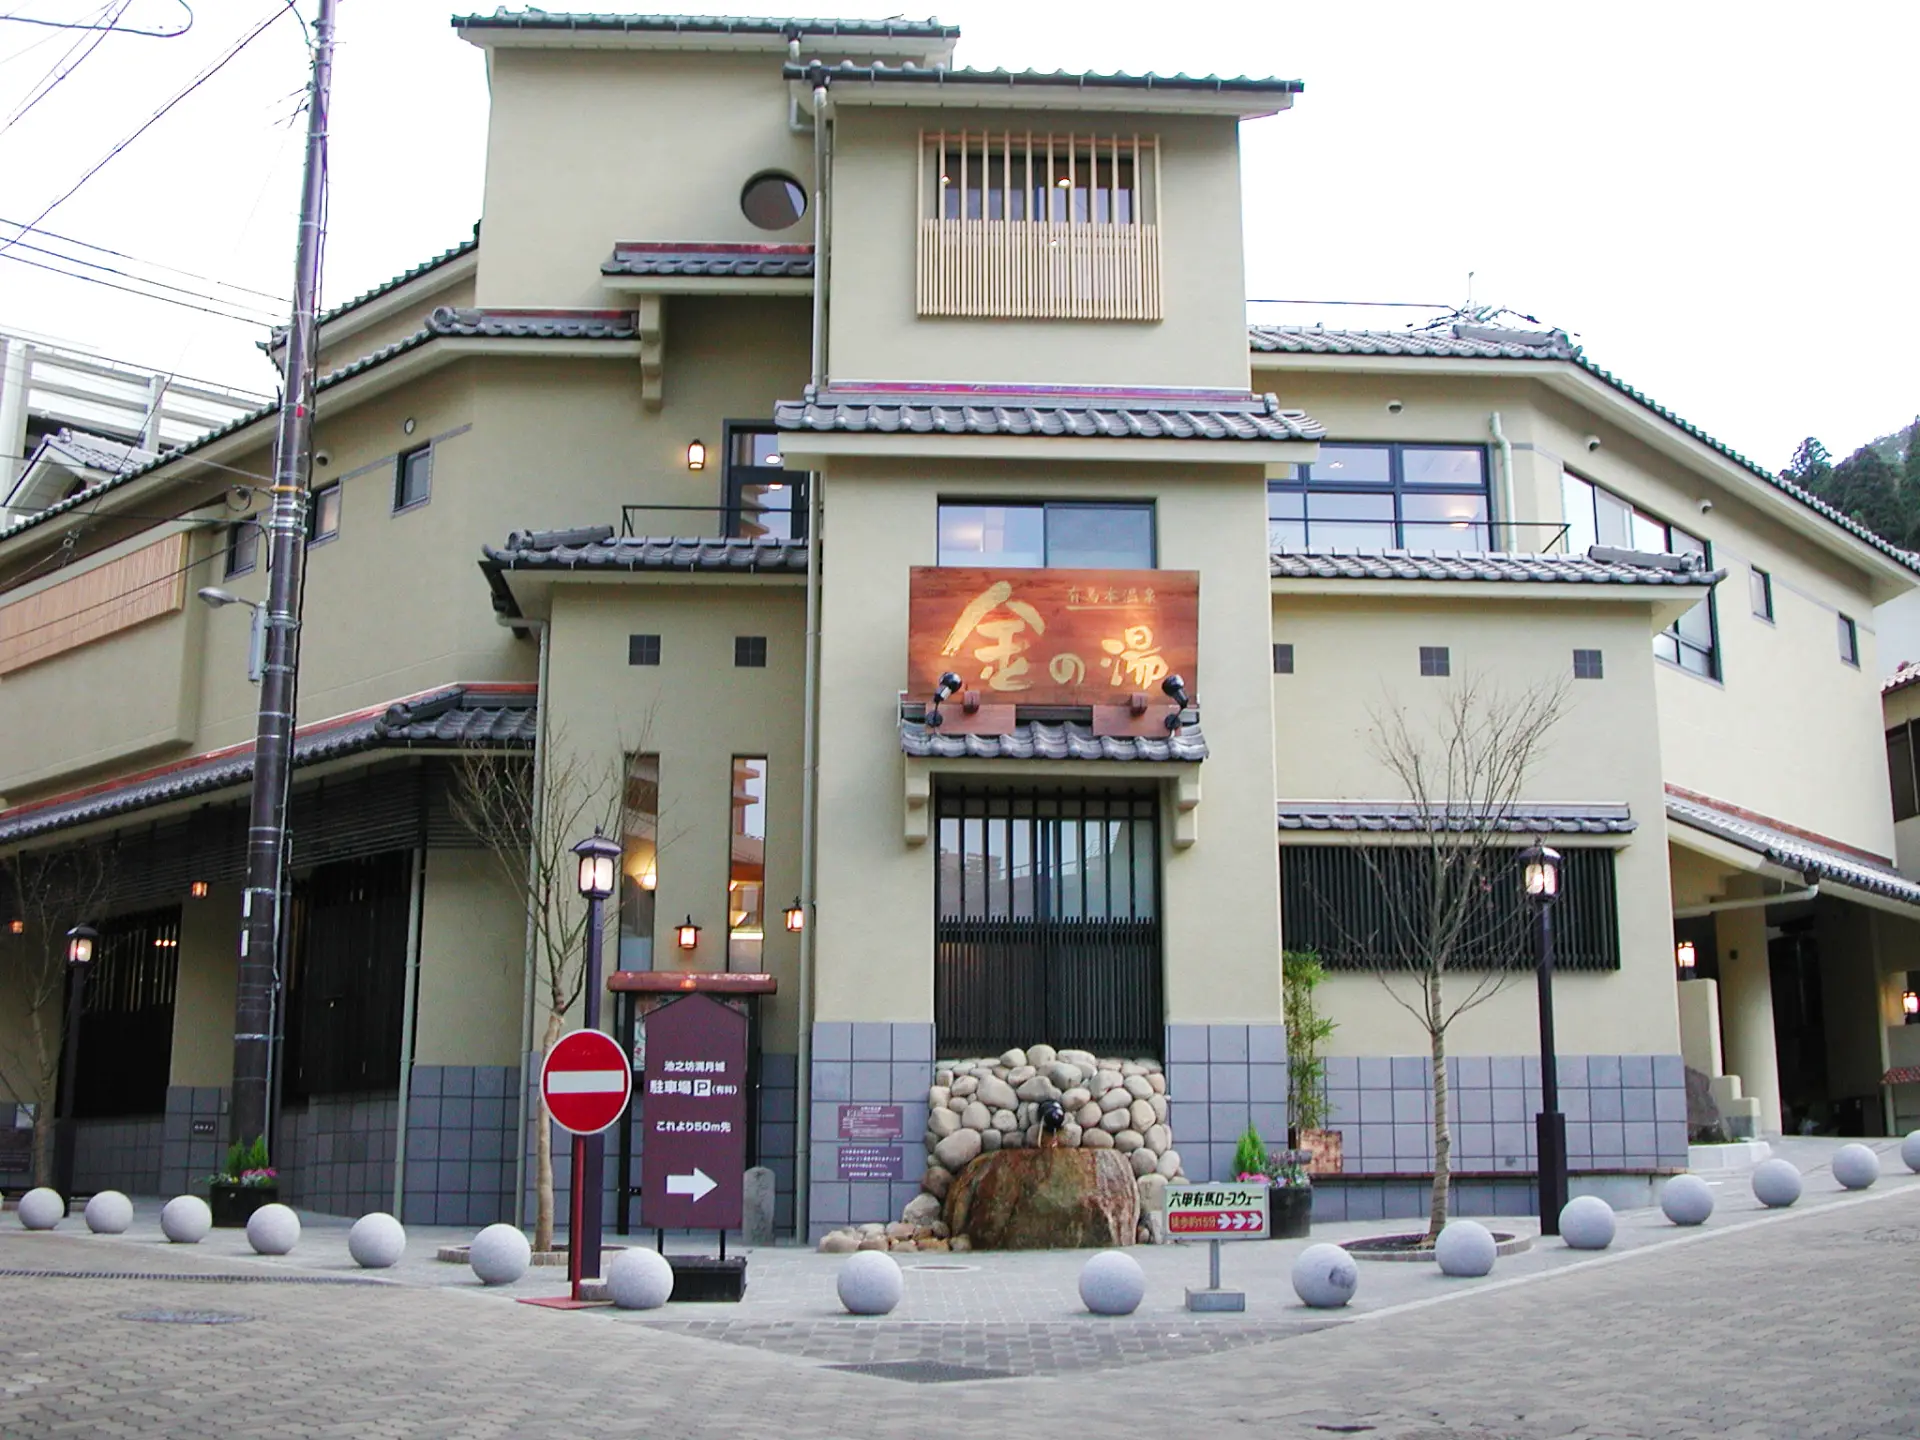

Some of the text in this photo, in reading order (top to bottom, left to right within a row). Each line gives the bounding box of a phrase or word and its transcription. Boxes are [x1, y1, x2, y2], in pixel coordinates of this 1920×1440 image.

[941, 580, 1169, 692] 金の湯
[649, 1079, 692, 1095] 駐車場
[656, 1121, 732, 1134] これより50m先
